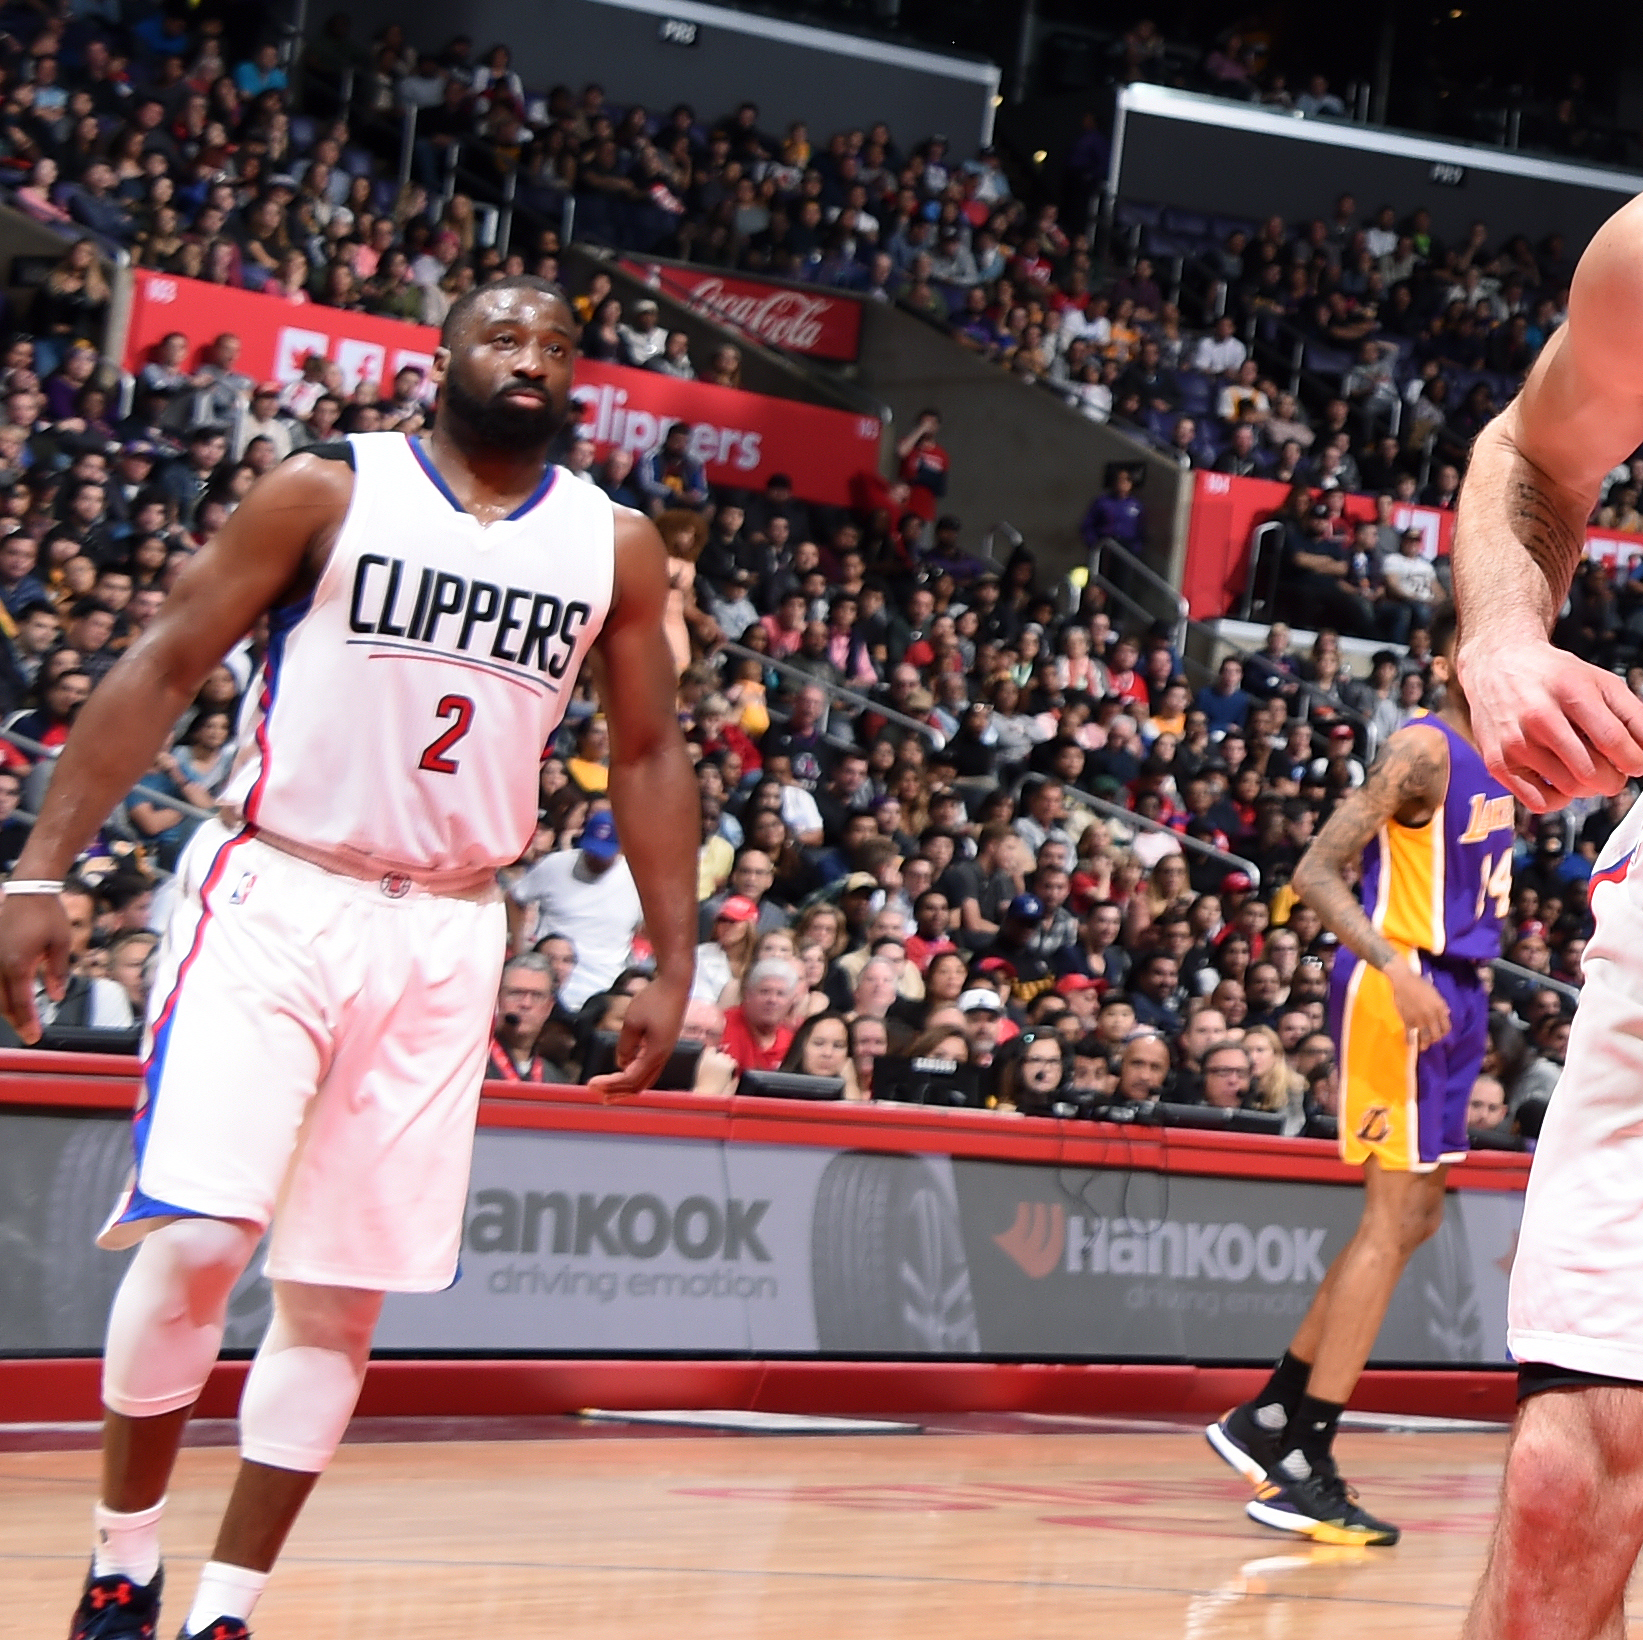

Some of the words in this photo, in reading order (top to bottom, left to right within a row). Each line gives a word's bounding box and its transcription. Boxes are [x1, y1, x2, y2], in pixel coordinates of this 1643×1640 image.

[349, 552, 592, 680] CLIPPERS
[418, 693, 475, 775] 2
[468, 1188, 773, 1262] ankook
[487, 1264, 618, 1303] driving
[627, 1266, 778, 1299] emotion
